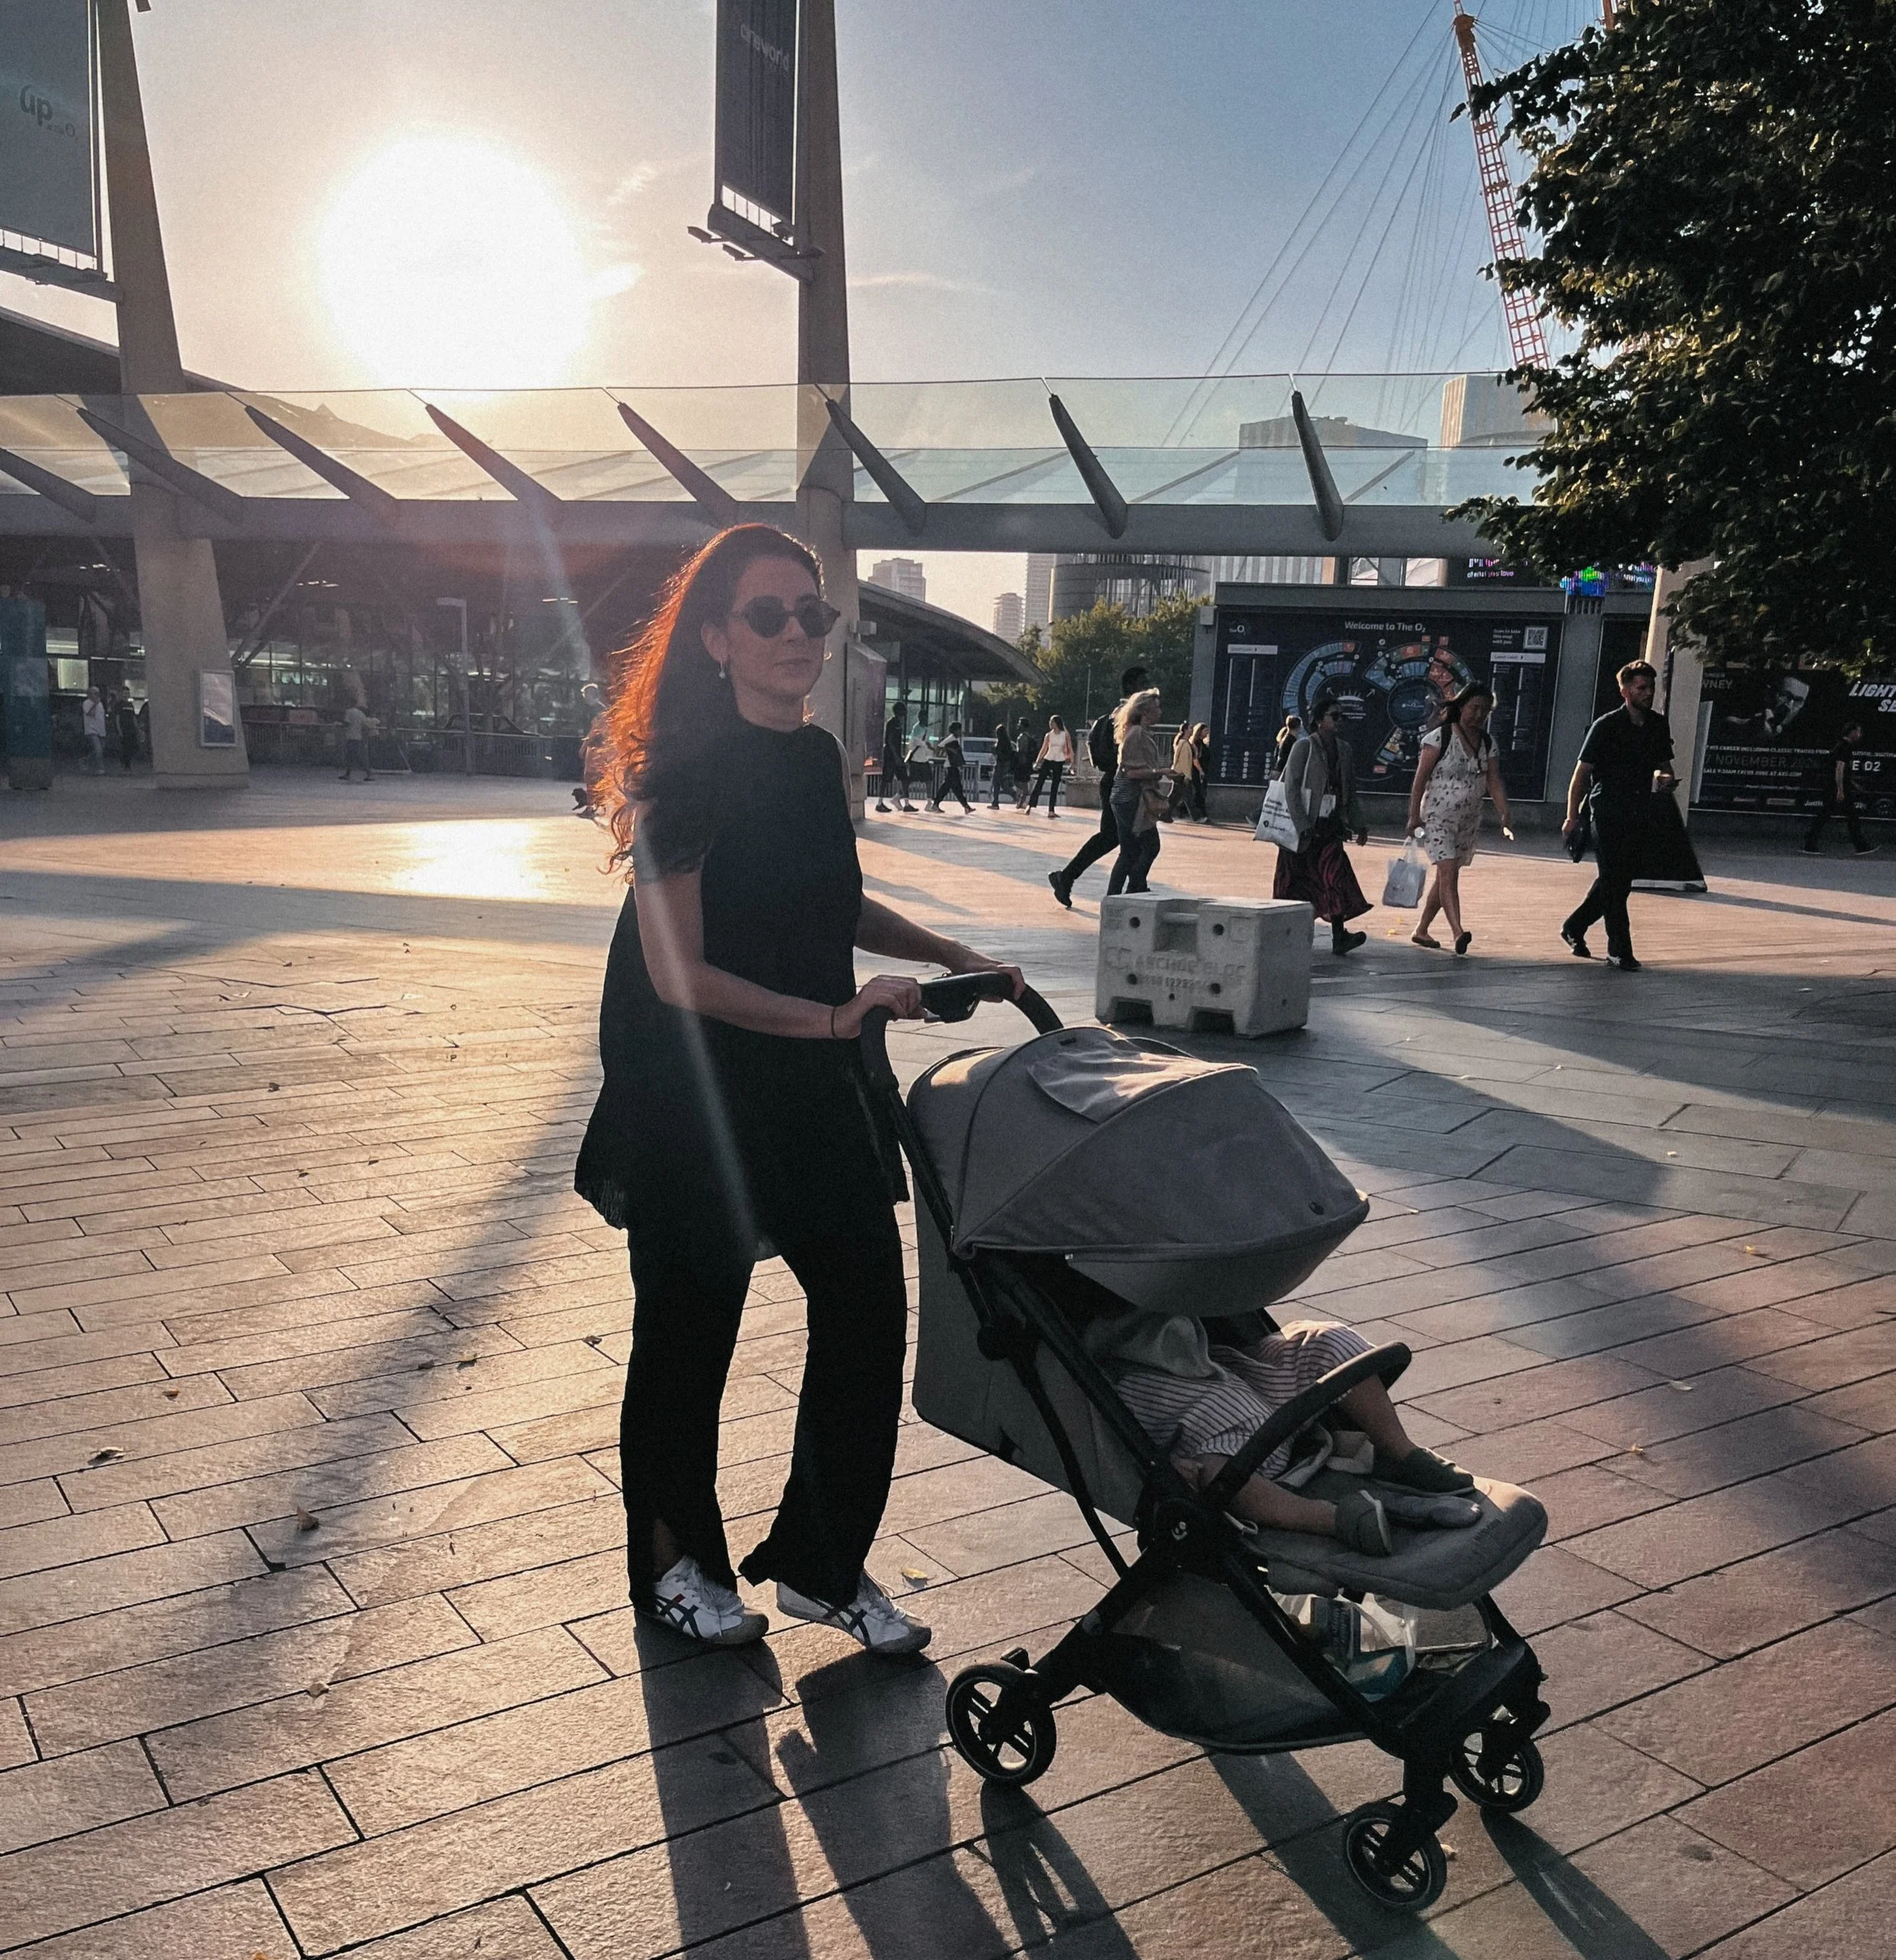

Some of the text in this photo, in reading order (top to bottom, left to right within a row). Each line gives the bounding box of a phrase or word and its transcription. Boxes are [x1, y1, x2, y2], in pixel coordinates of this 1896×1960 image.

[1344, 621, 1383, 631] Welcome
[1385, 622, 1395, 631] to
[1396, 622, 1414, 632] The
[1848, 683, 1896, 698] LIGHT
[1878, 699, 1896, 712] SE
[1715, 754, 1787, 768] NOVEMBER
